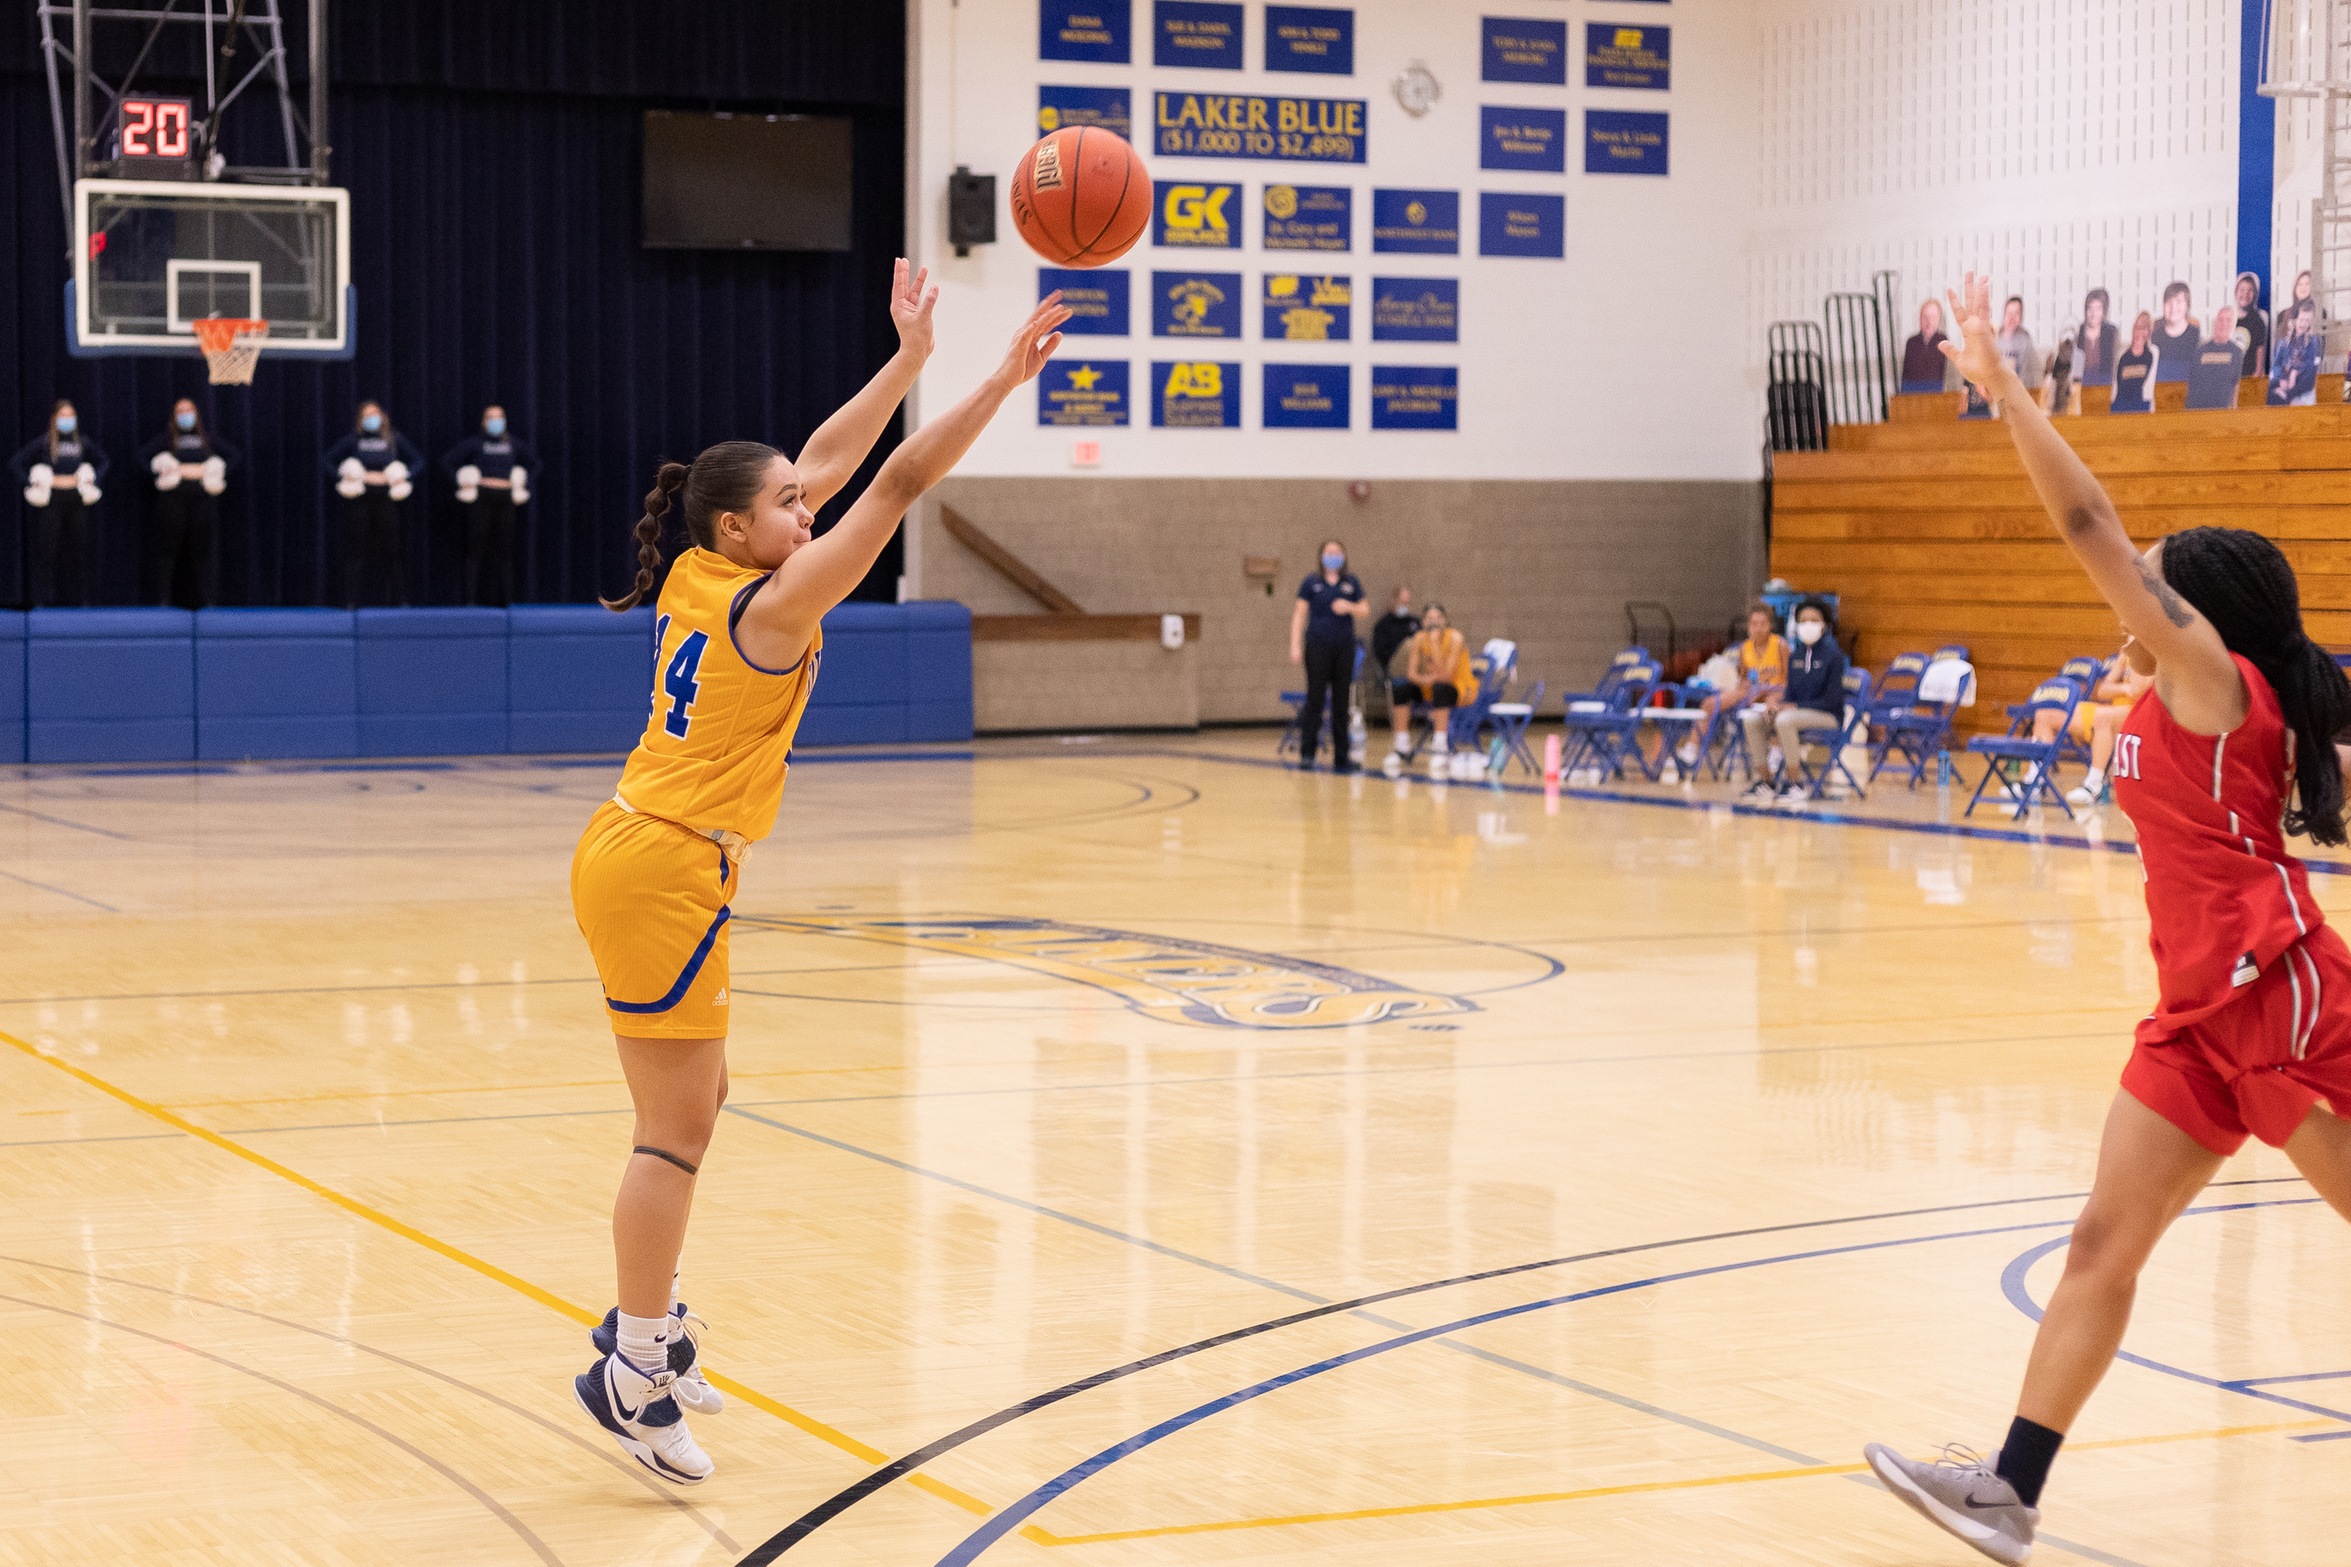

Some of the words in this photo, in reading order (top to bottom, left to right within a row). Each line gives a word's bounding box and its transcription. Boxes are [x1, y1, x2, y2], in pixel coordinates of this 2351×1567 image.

[123, 102, 188, 156] 20
[1158, 95, 1271, 131] LAKER
[1278, 99, 1363, 135] BLUE
[1245, 132, 1274, 154] TO
[1164, 186, 1232, 229] GK
[1164, 363, 1223, 397] AB
[649, 612, 710, 741] 14
